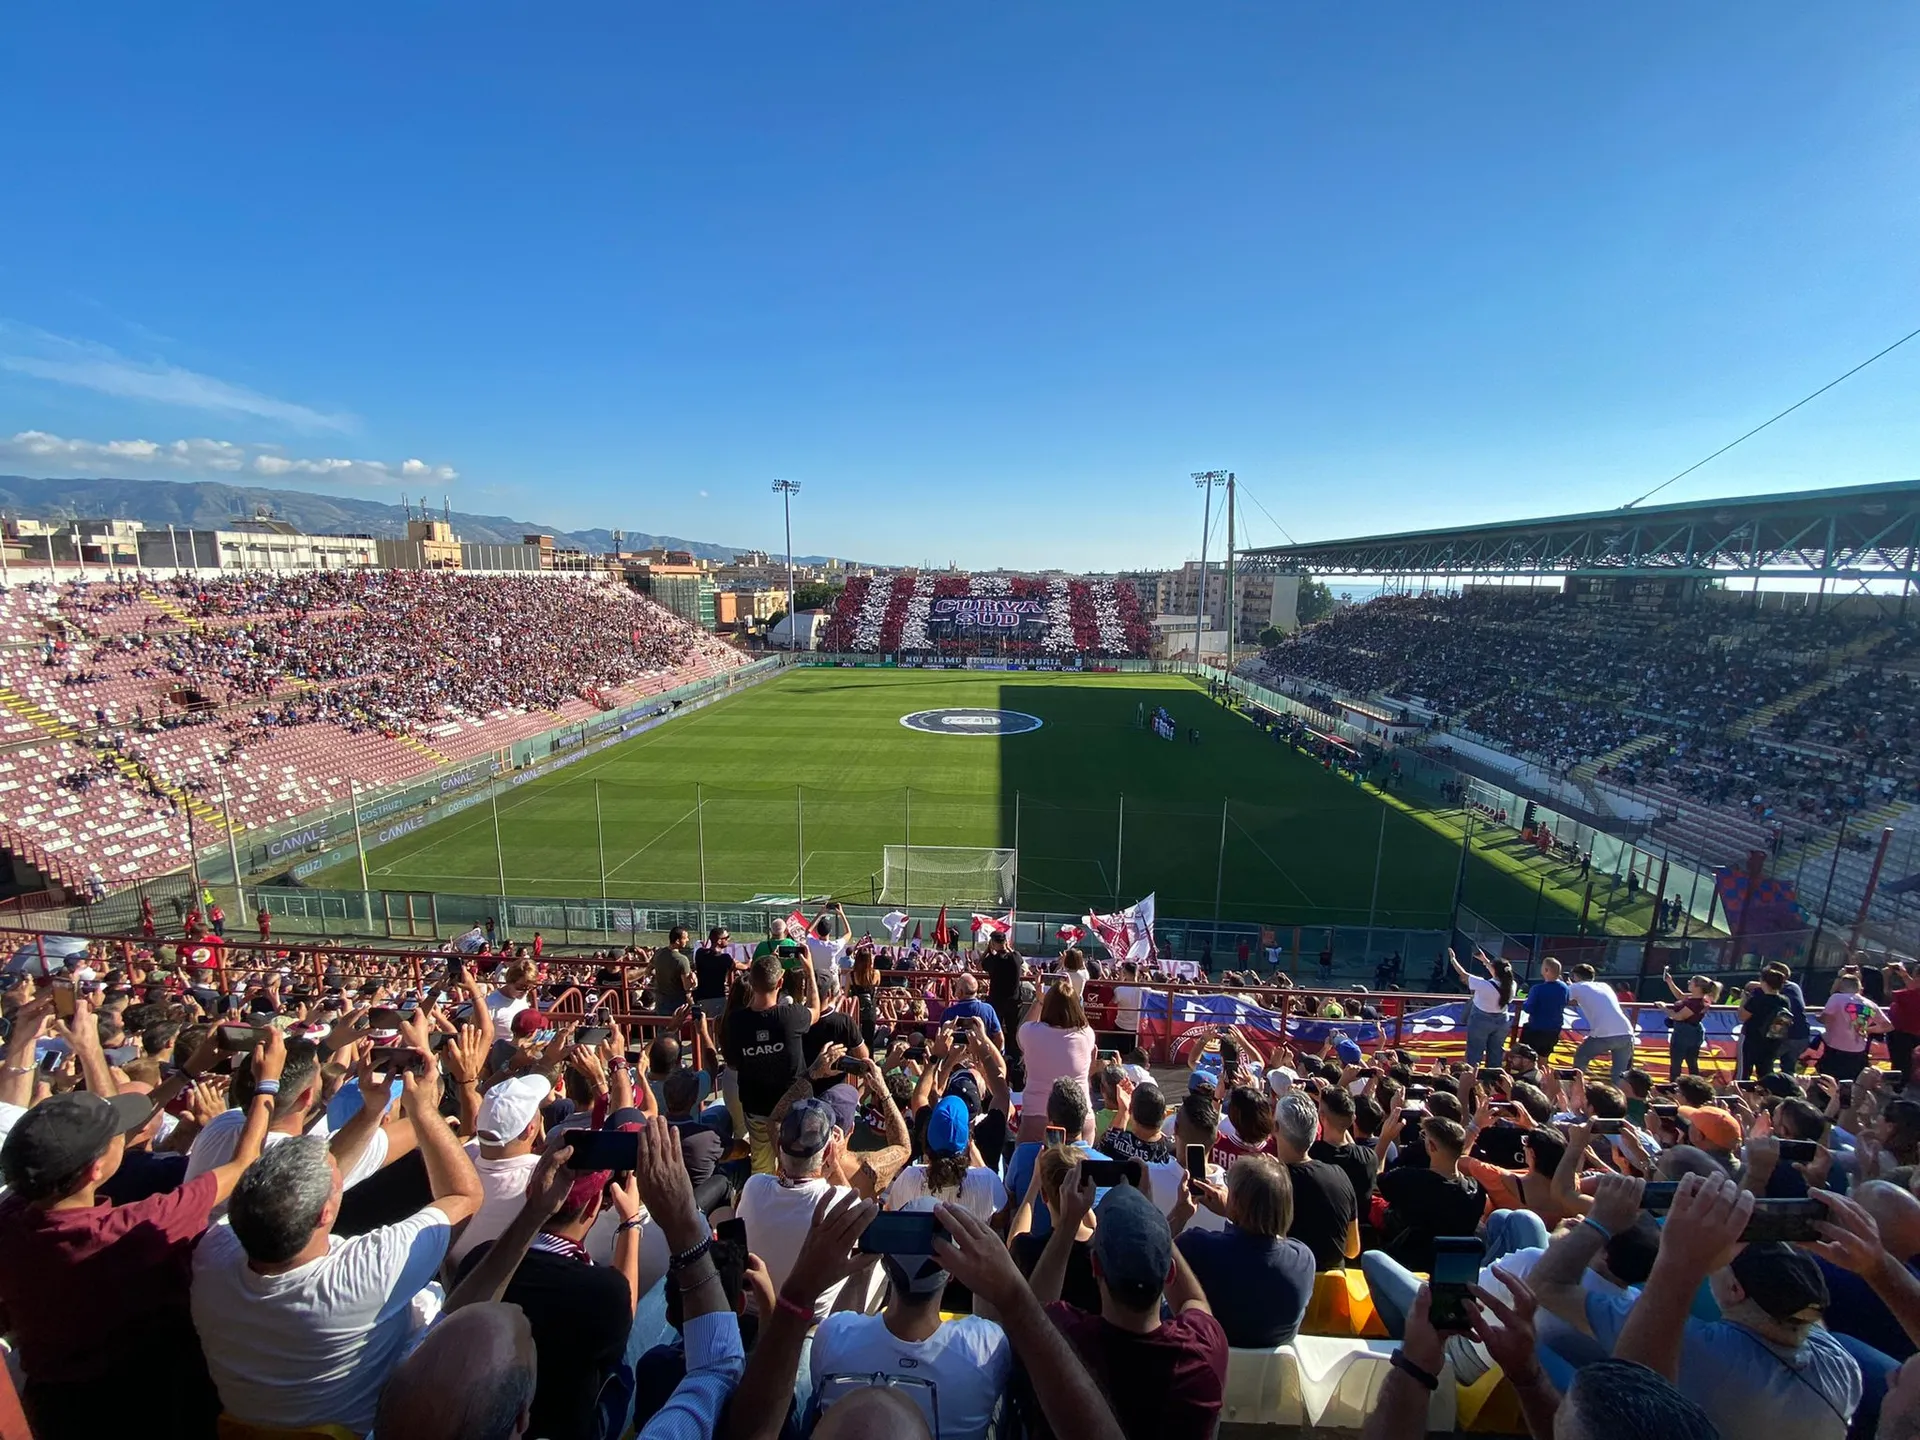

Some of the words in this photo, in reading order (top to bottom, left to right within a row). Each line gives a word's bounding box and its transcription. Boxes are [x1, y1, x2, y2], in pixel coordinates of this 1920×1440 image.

[935, 599, 1043, 613] CURVA
[955, 612, 1019, 626] SUD
[441, 769, 477, 790] CANALE
[513, 767, 542, 785] CANALE
[360, 799, 403, 821] COSTRUZI
[379, 815, 425, 842] CANALE
[271, 824, 329, 855] CANALE
[742, 1042, 784, 1056] ICARO
[1113, 1140, 1149, 1160] WILDCATS
